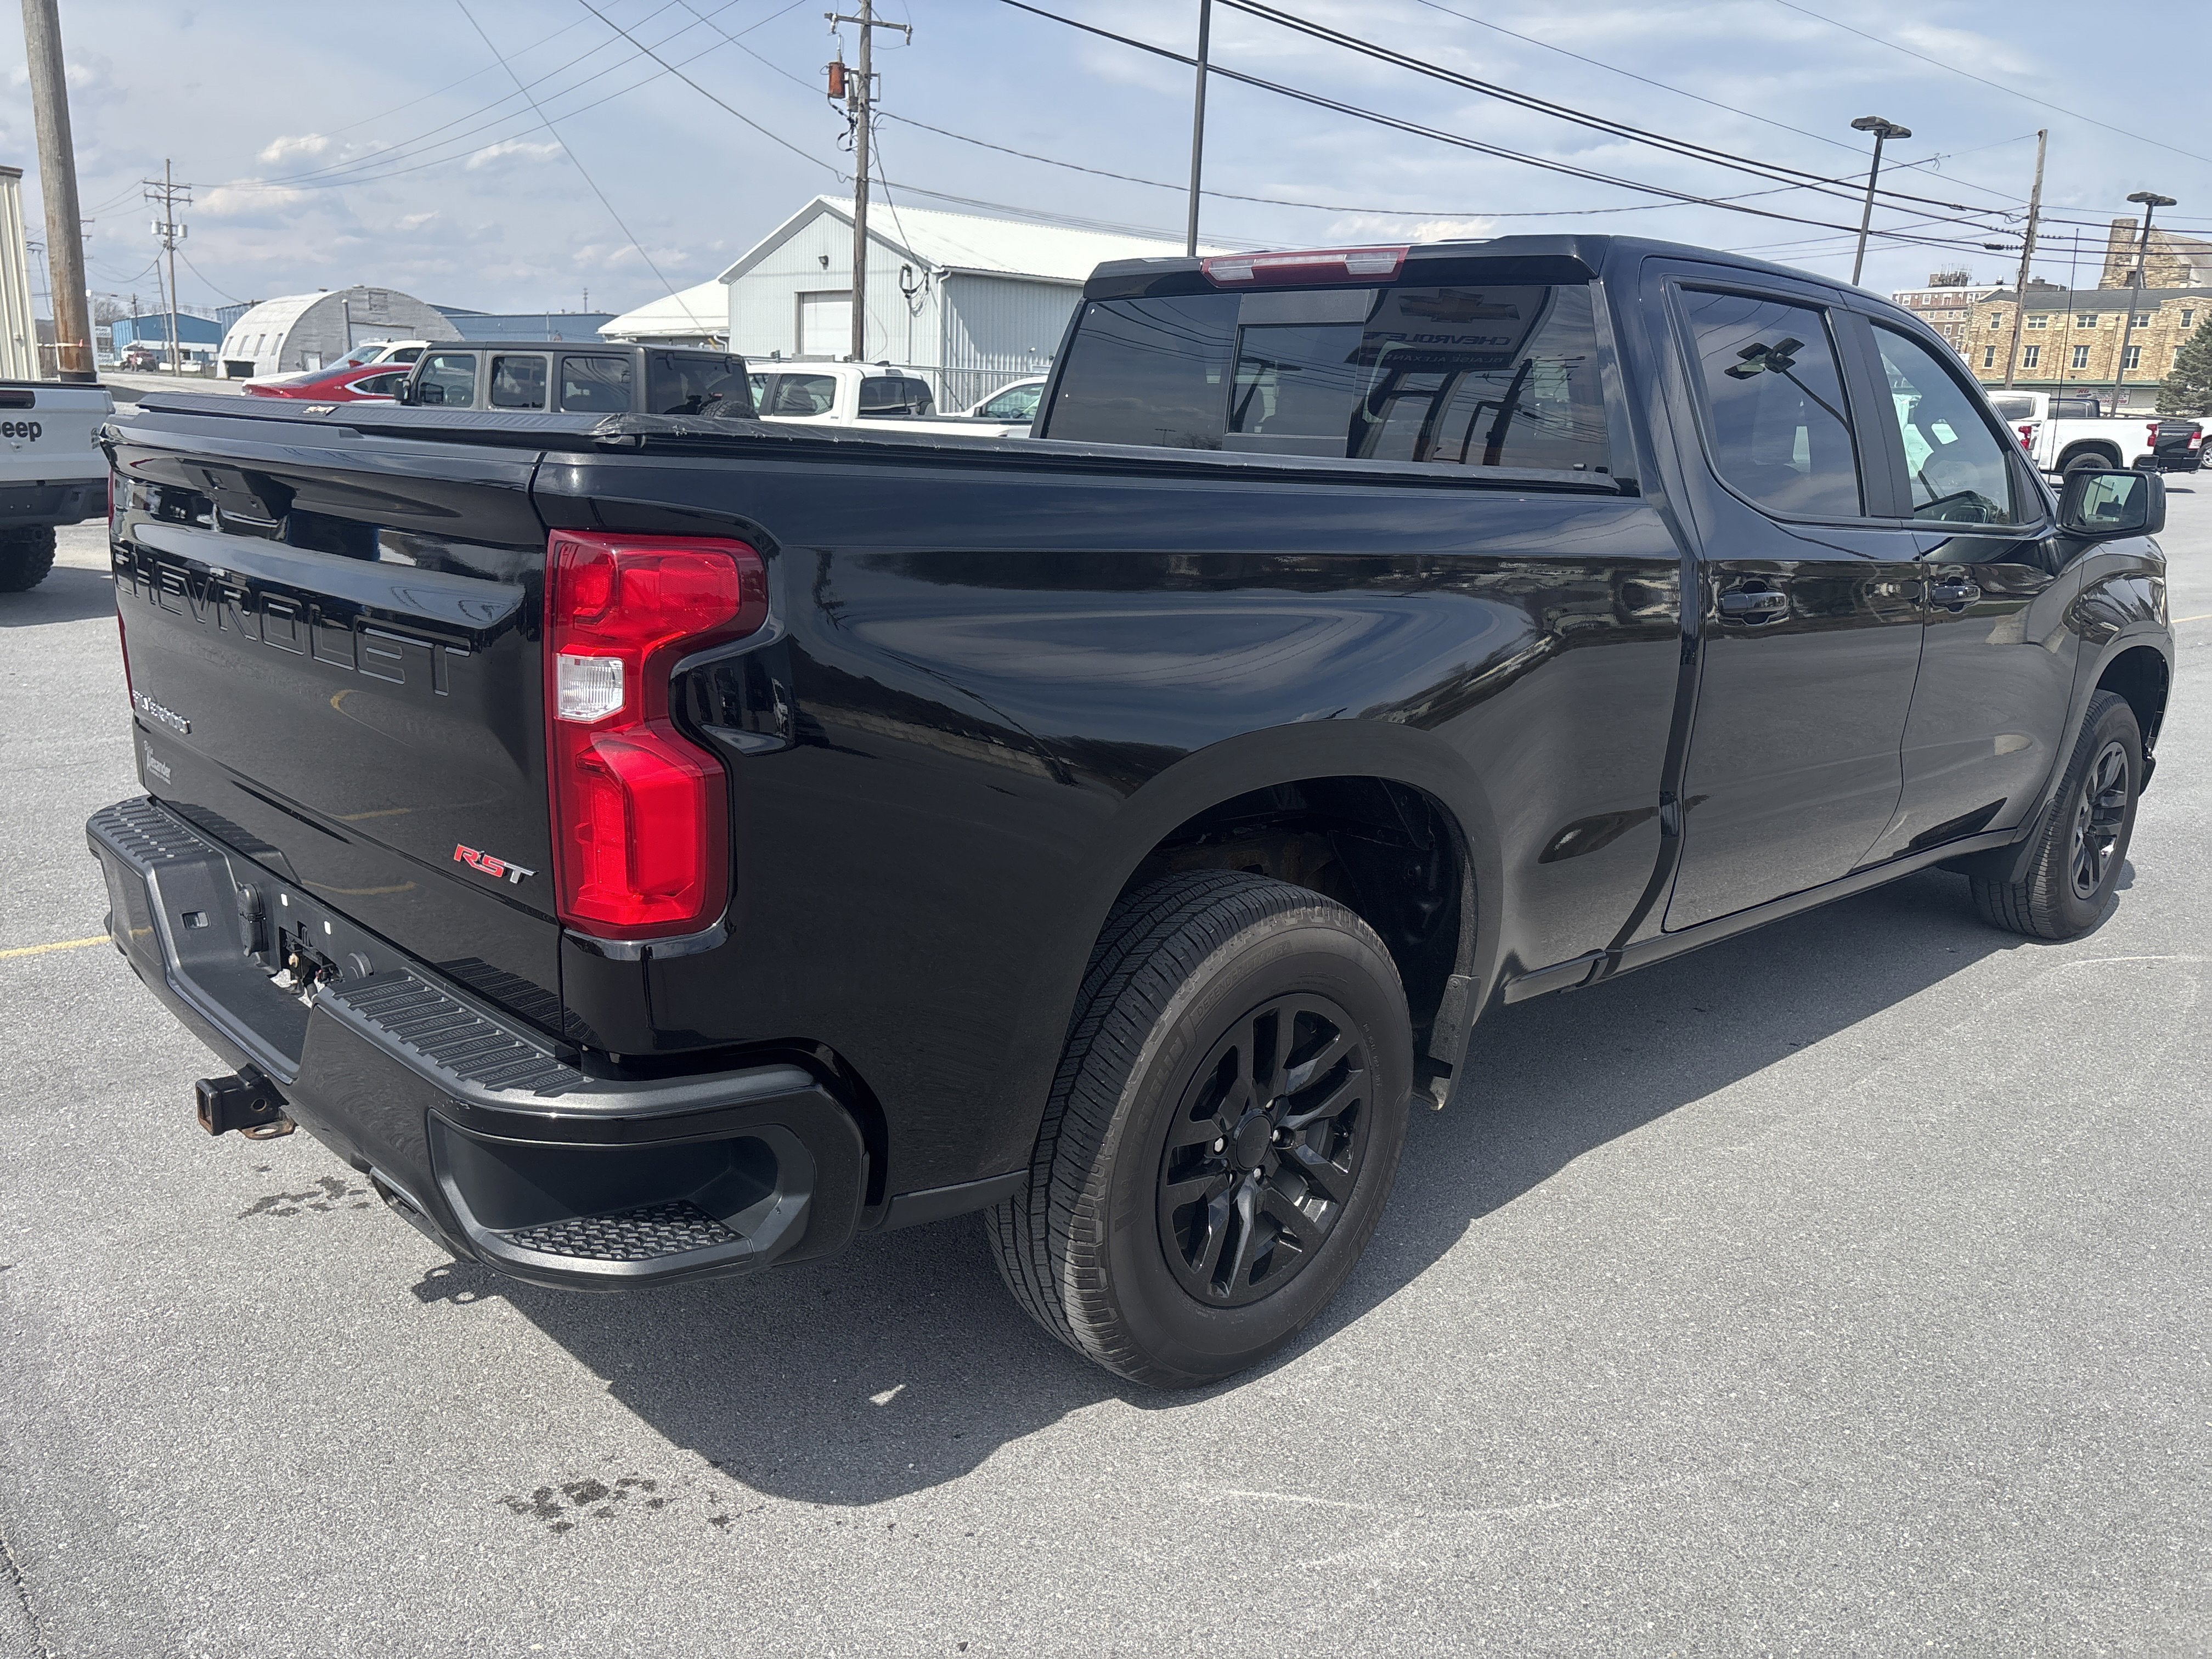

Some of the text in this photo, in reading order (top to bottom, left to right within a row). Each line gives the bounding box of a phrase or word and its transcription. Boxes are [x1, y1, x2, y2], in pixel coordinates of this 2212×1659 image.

[0, 421, 42, 442] eep
[113, 543, 471, 696] CHEVROLET
[453, 843, 535, 884] RST
[1197, 966, 1245, 1018] DEFENDER
